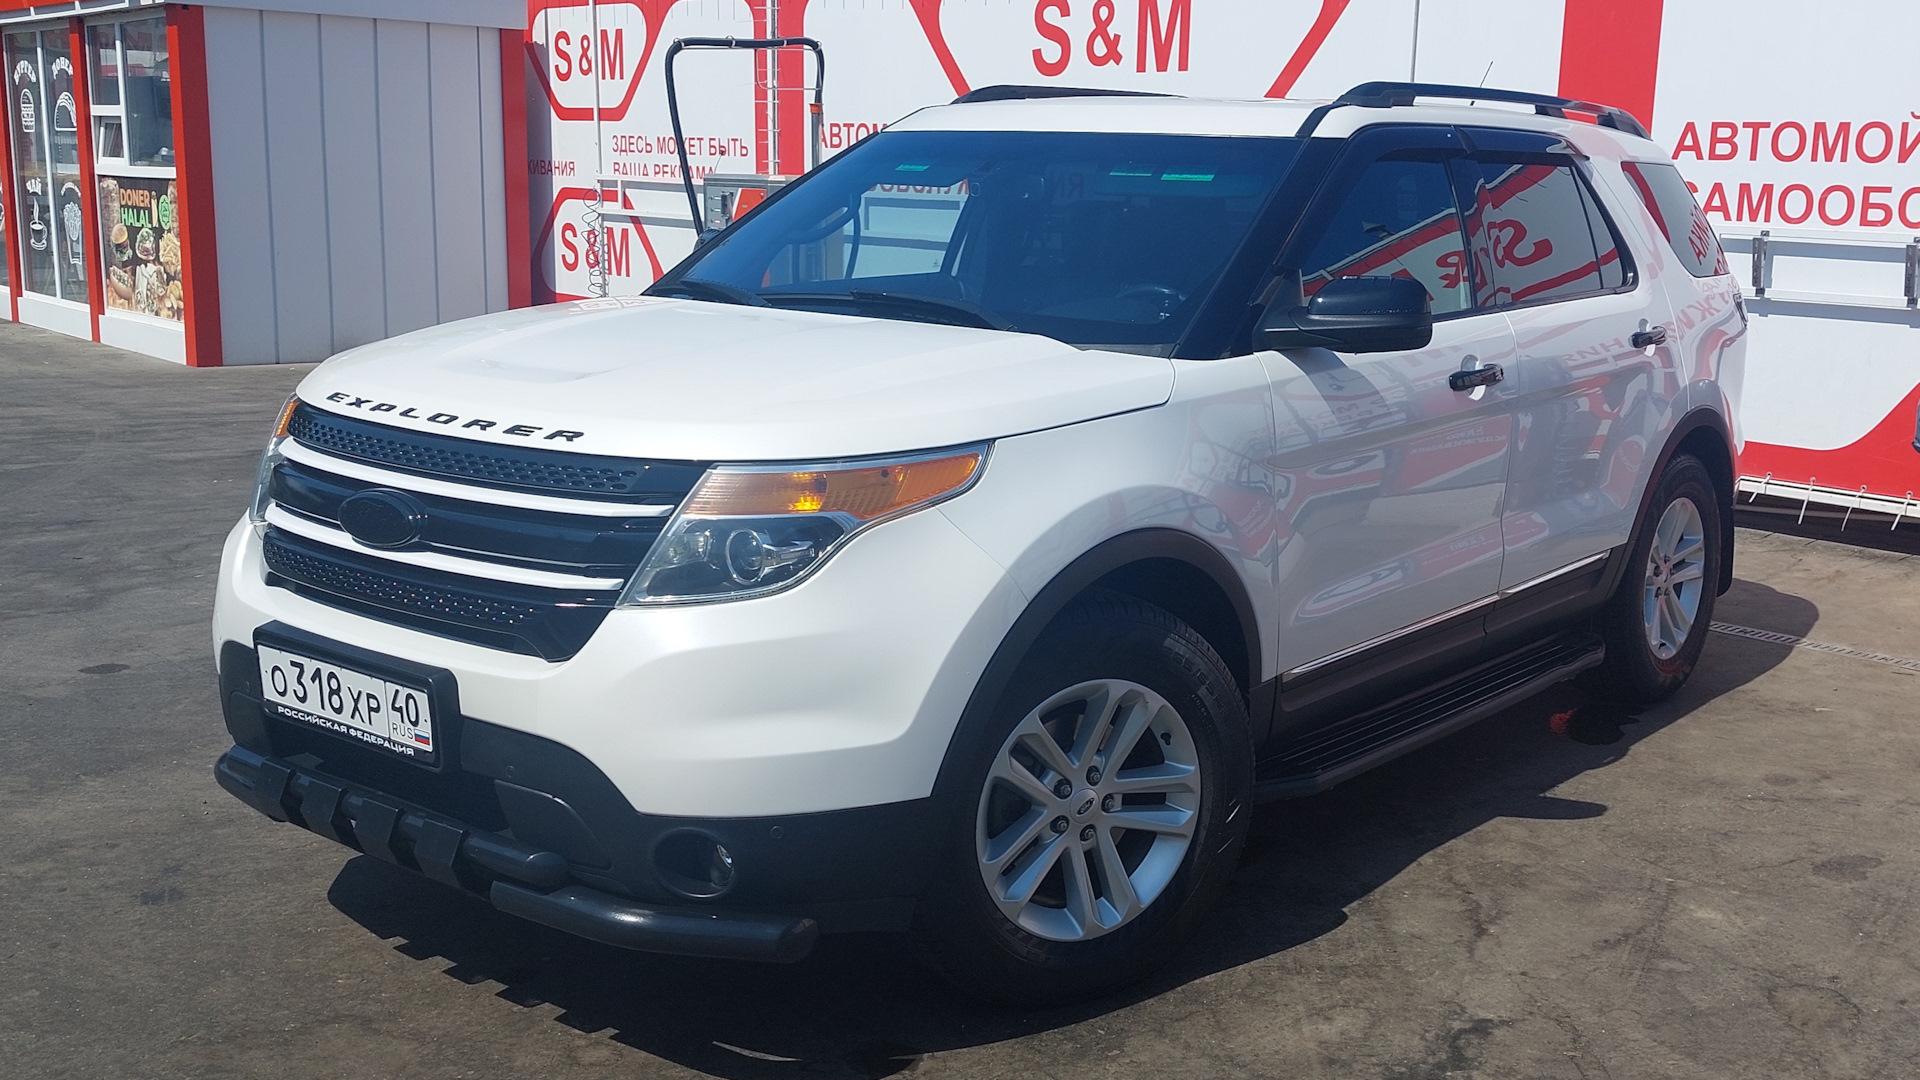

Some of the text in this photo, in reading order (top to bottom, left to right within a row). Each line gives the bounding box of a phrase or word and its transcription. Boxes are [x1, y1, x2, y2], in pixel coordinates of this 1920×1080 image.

[612, 134, 653, 156] ЗДЕСЬ
[708, 138, 749, 157] БЫТЬ
[820, 122, 888, 149] АВТО
[120, 188, 150, 207] DONER
[1684, 180, 1920, 230] АМООБС
[121, 207, 152, 228] HALAL
[326, 391, 585, 442] EXPLORER
[277, 706, 415, 757] РОССИЙСКАЯ ФЕДЕРАЦИЯ
[391, 722, 414, 740] RUS
